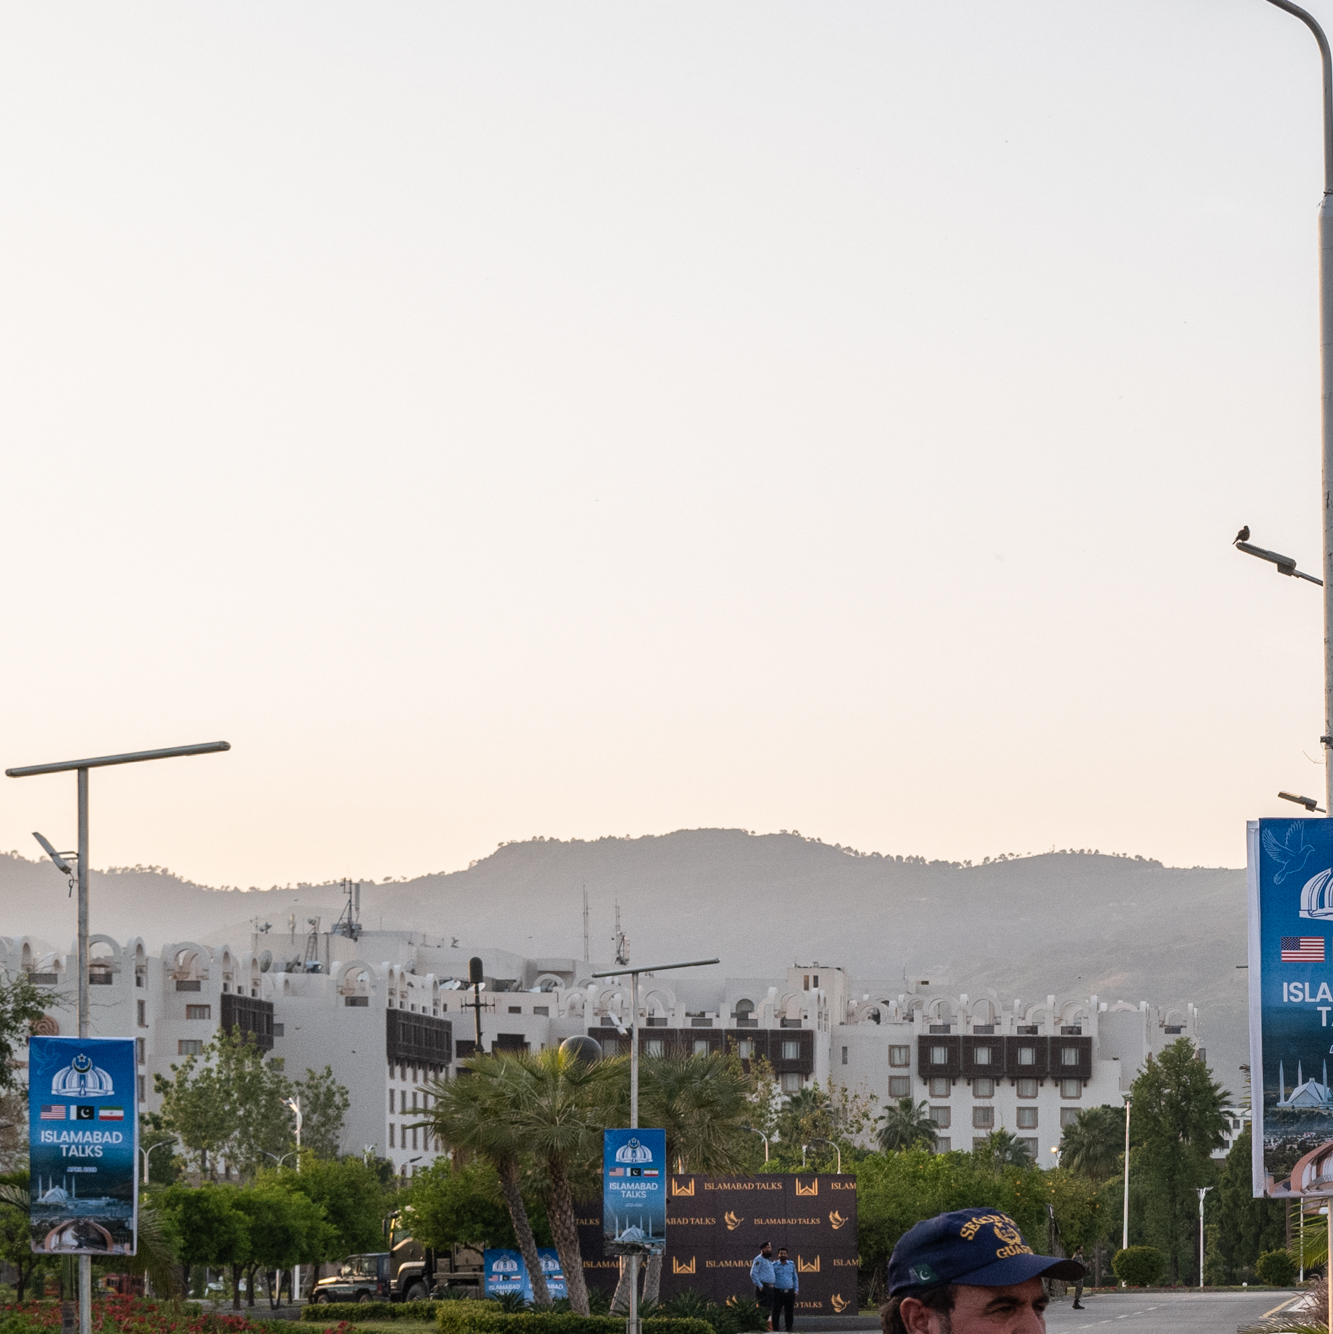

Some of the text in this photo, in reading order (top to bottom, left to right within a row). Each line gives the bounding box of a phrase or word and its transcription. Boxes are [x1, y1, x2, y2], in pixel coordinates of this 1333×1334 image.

[41, 1130, 123, 1144] ISLAMABAD
[60, 1145, 103, 1158] TALKS
[609, 1182, 658, 1191] ISLAMABAD
[704, 1182, 783, 1190] ISLAMABAD TALKS
[576, 1218, 600, 1226] TALKS
[690, 1217, 716, 1225] TALKS
[800, 1301, 823, 1309] TALKS
